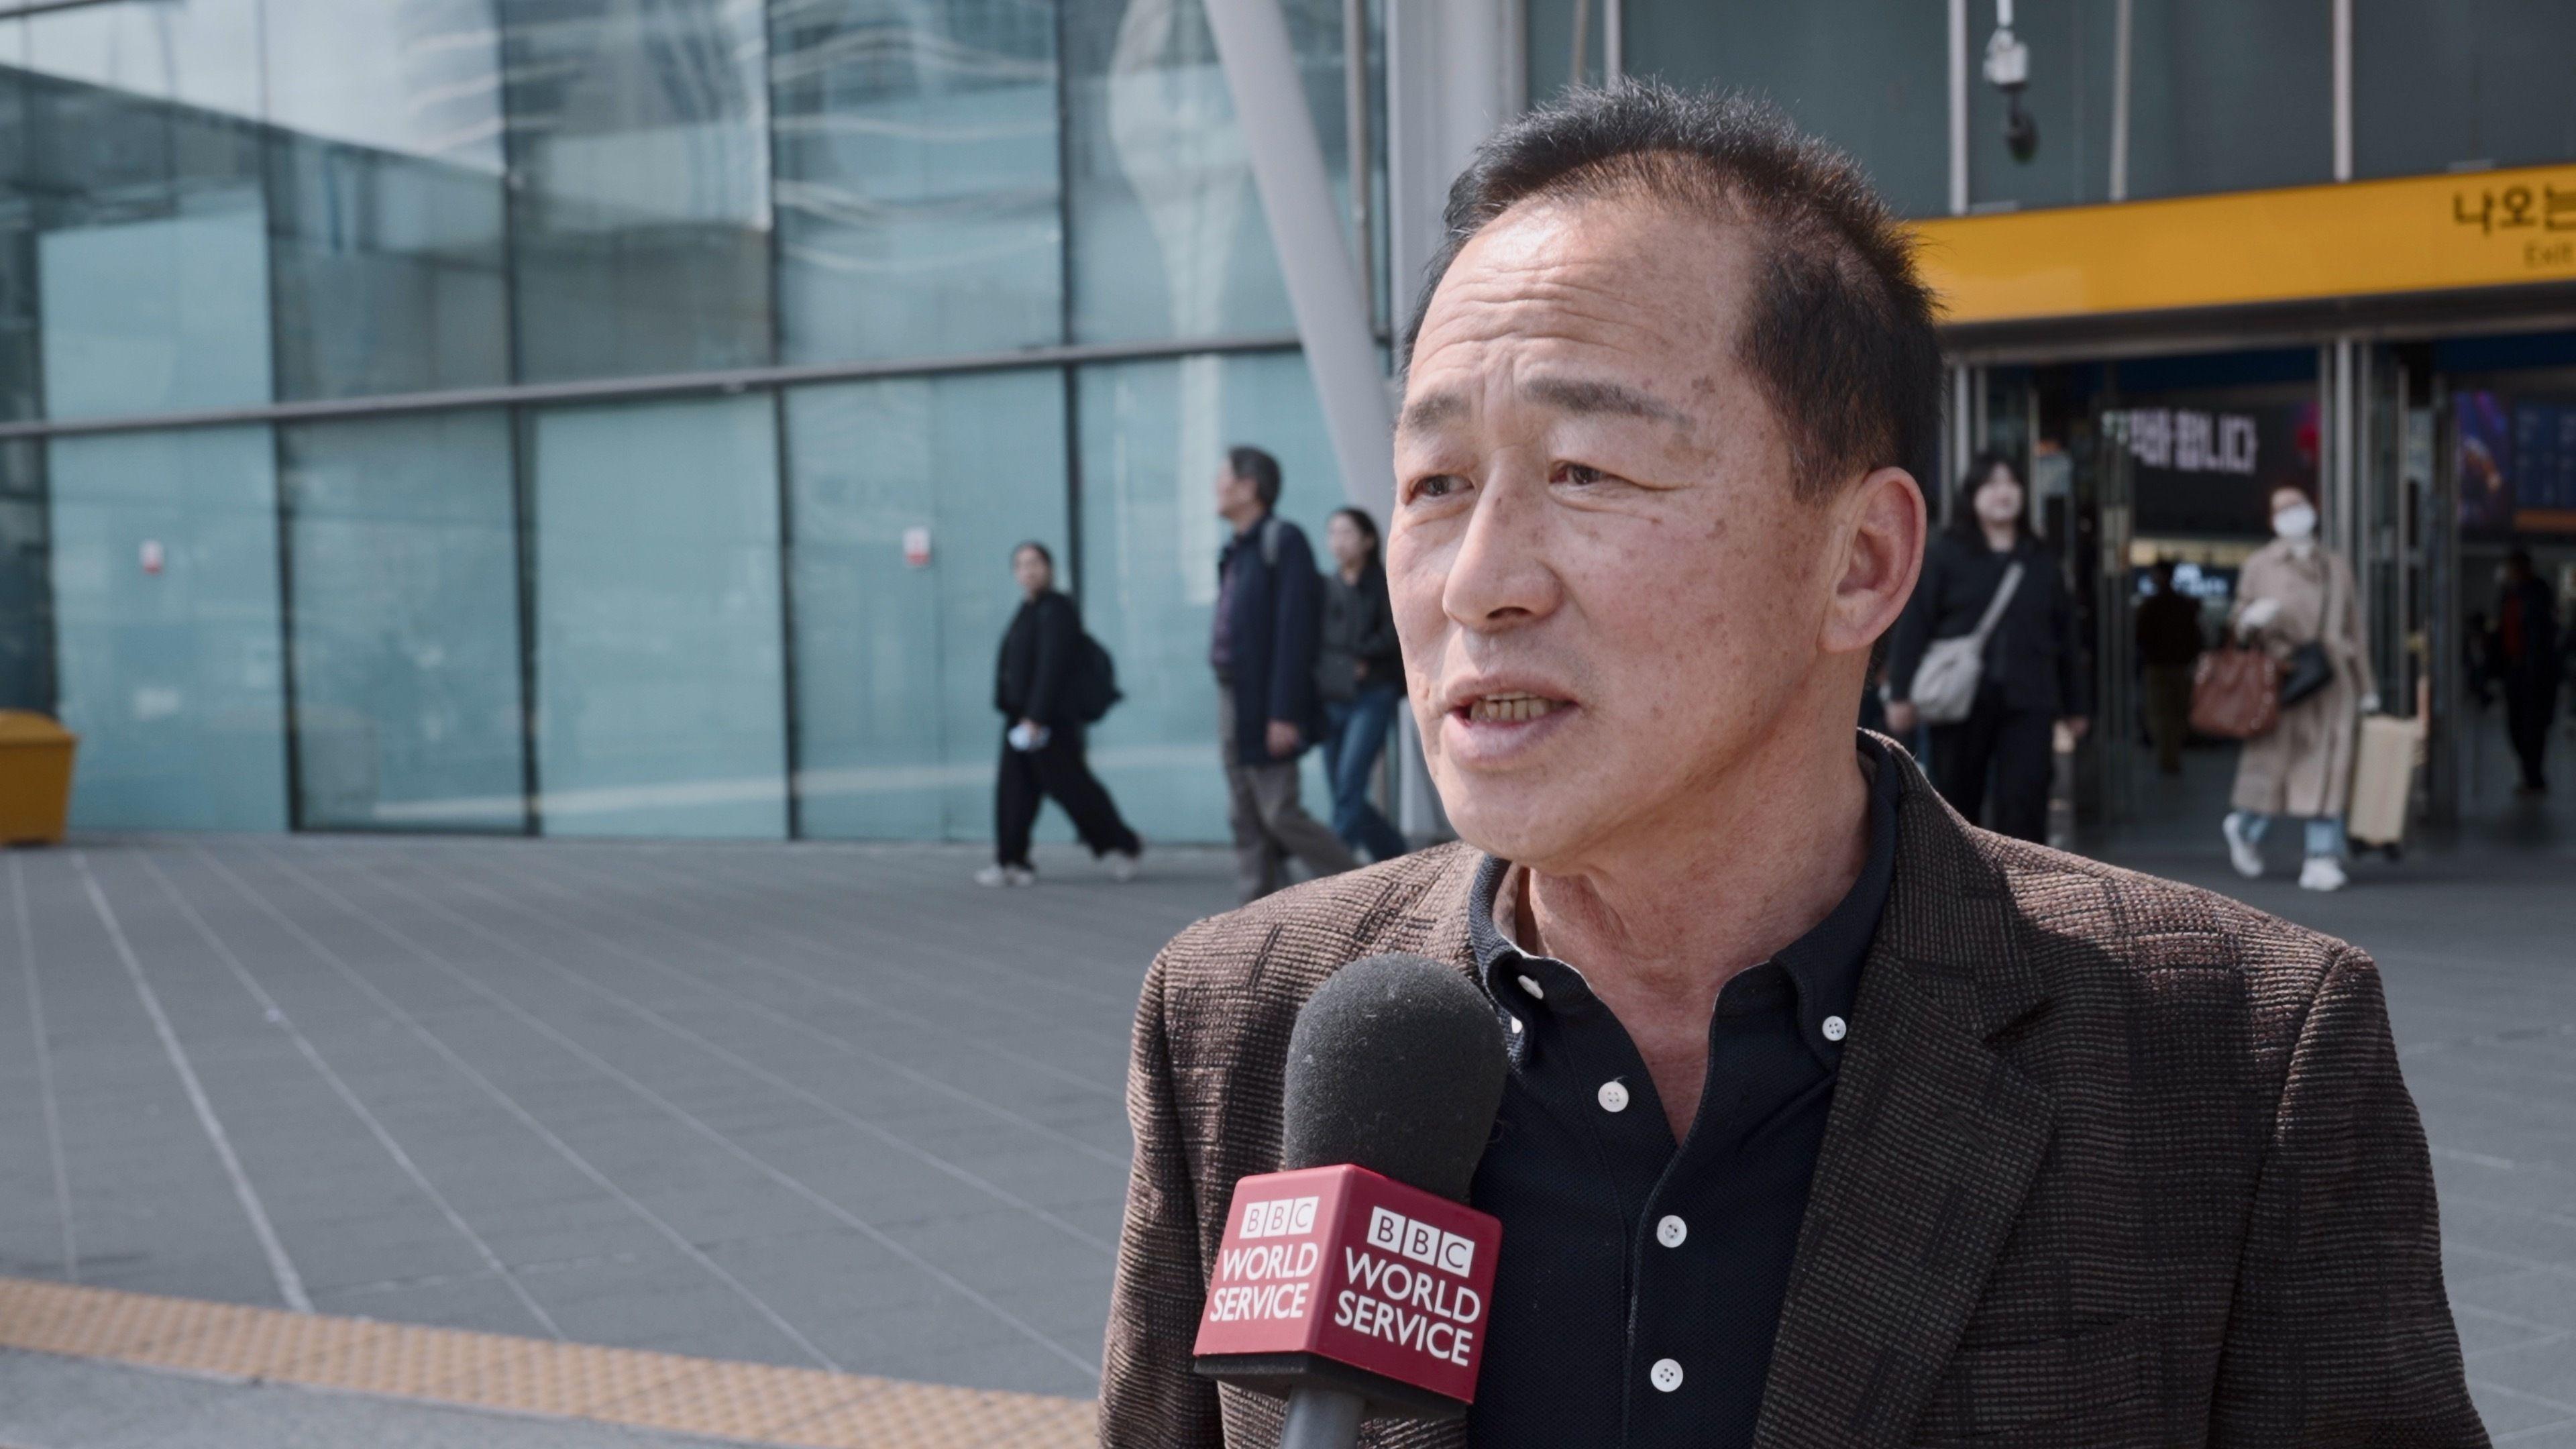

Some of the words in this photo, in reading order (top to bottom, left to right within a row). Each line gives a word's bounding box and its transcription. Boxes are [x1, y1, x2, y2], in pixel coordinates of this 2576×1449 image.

[2453, 182, 2576, 235] 나오는
[1243, 1199, 1316, 1236] BBC
[1372, 1211, 1471, 1274] BBC
[1222, 1242, 1319, 1282] WORLD
[1345, 1246, 1481, 1324] WORLD
[1210, 1283, 1309, 1322] SERVICE
[1334, 1290, 1474, 1367] SERVICE
